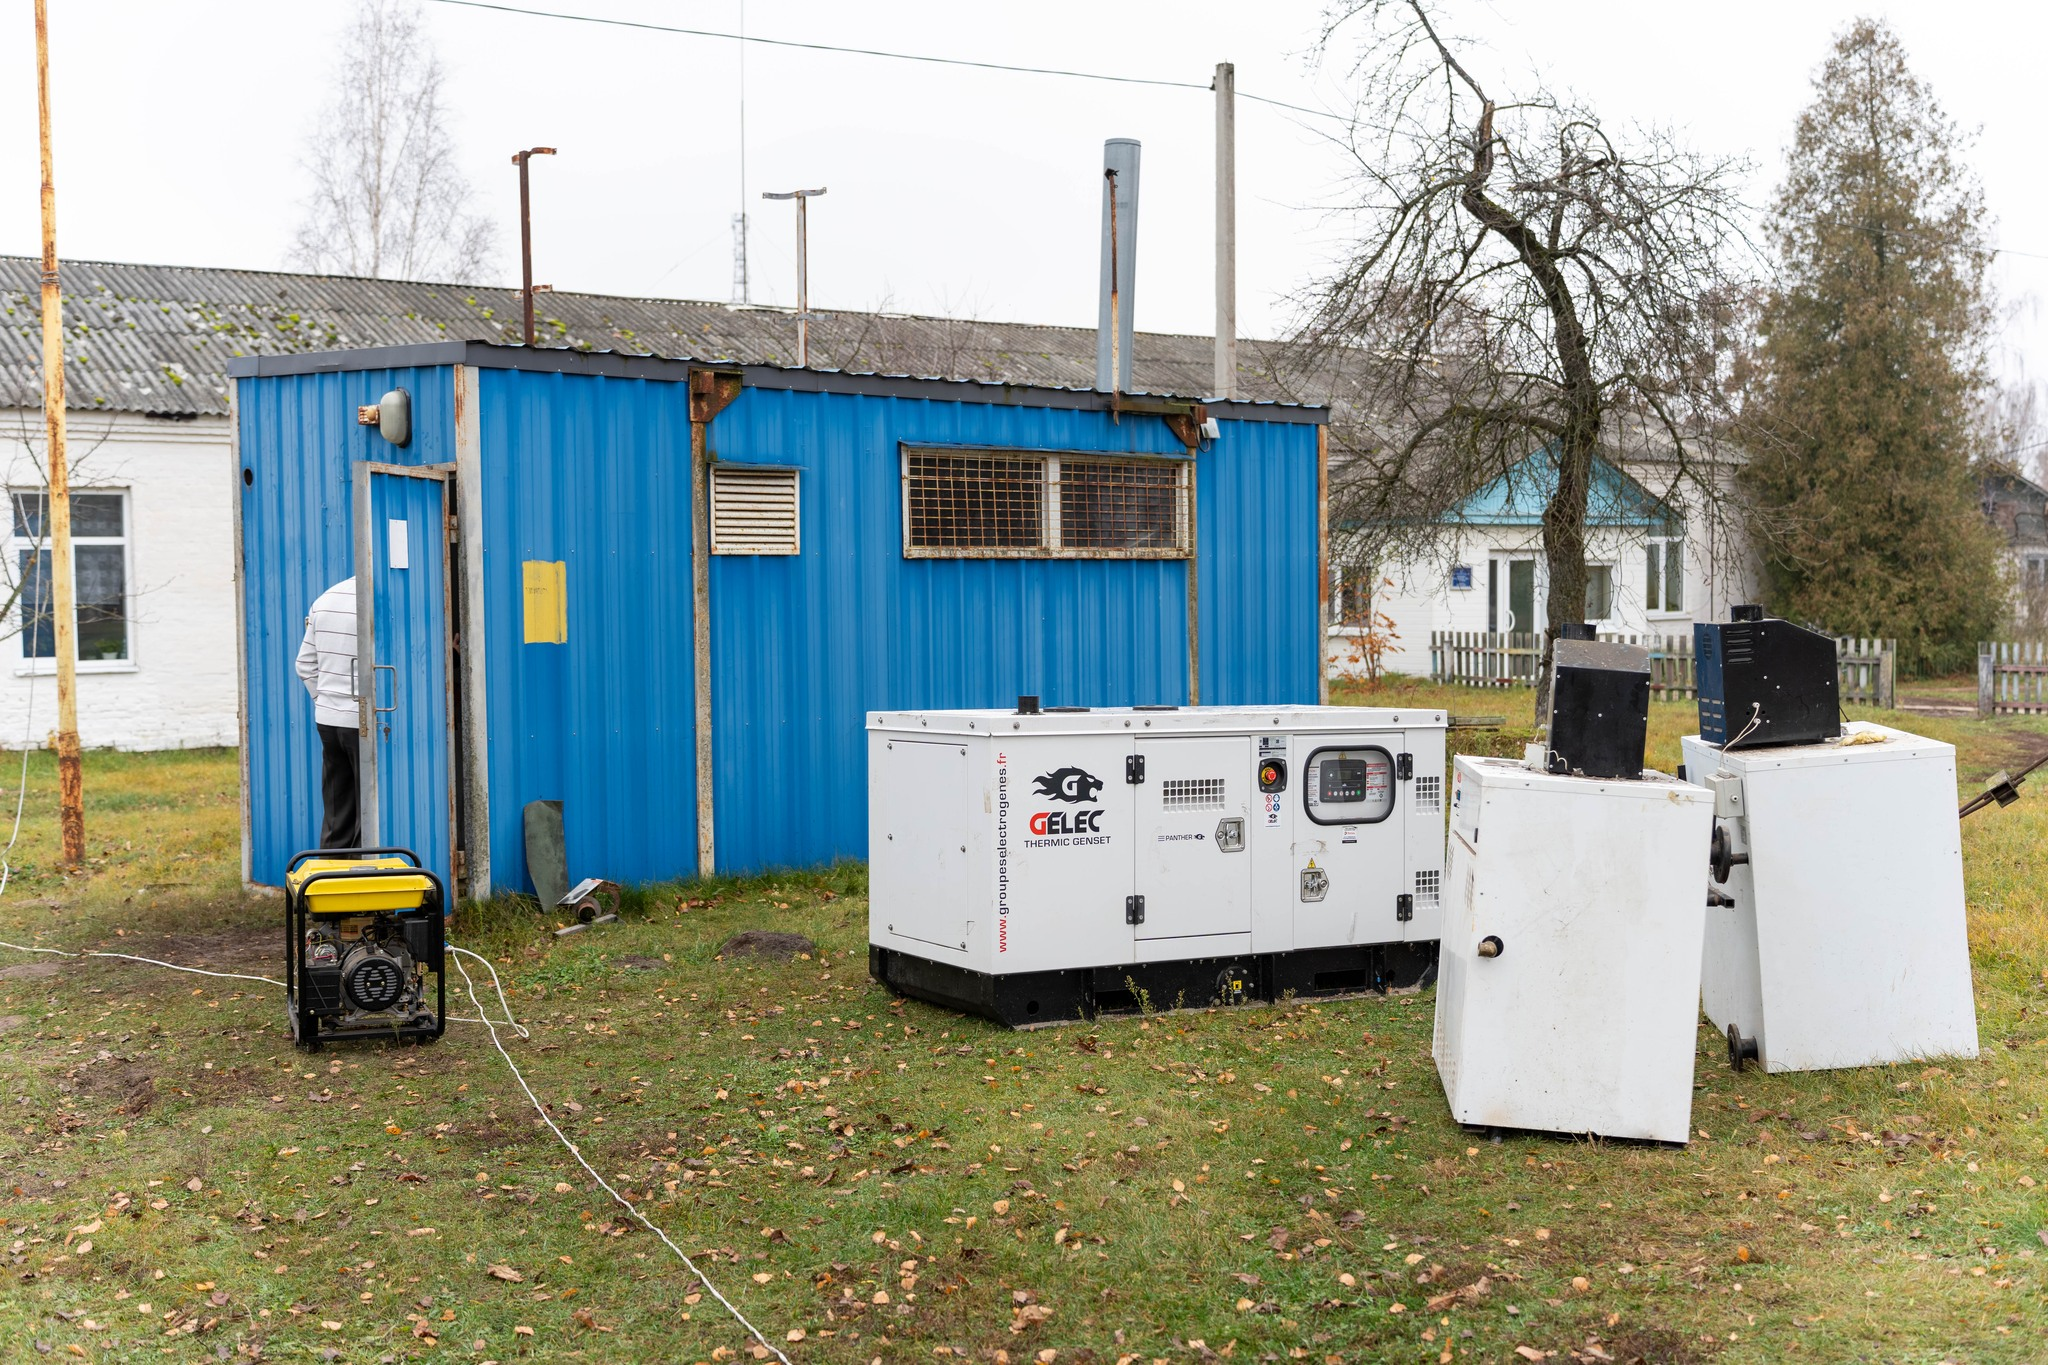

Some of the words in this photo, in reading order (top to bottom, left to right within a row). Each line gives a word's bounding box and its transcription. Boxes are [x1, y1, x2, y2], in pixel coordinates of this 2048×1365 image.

[1062, 775, 1081, 796] G
[1030, 809, 1106, 835] GELEC
[997, 752, 1010, 953] www.groupeselectrogenes.fr
[1024, 837, 1070, 848] THERMIC
[1072, 836, 1111, 846] GENSET
